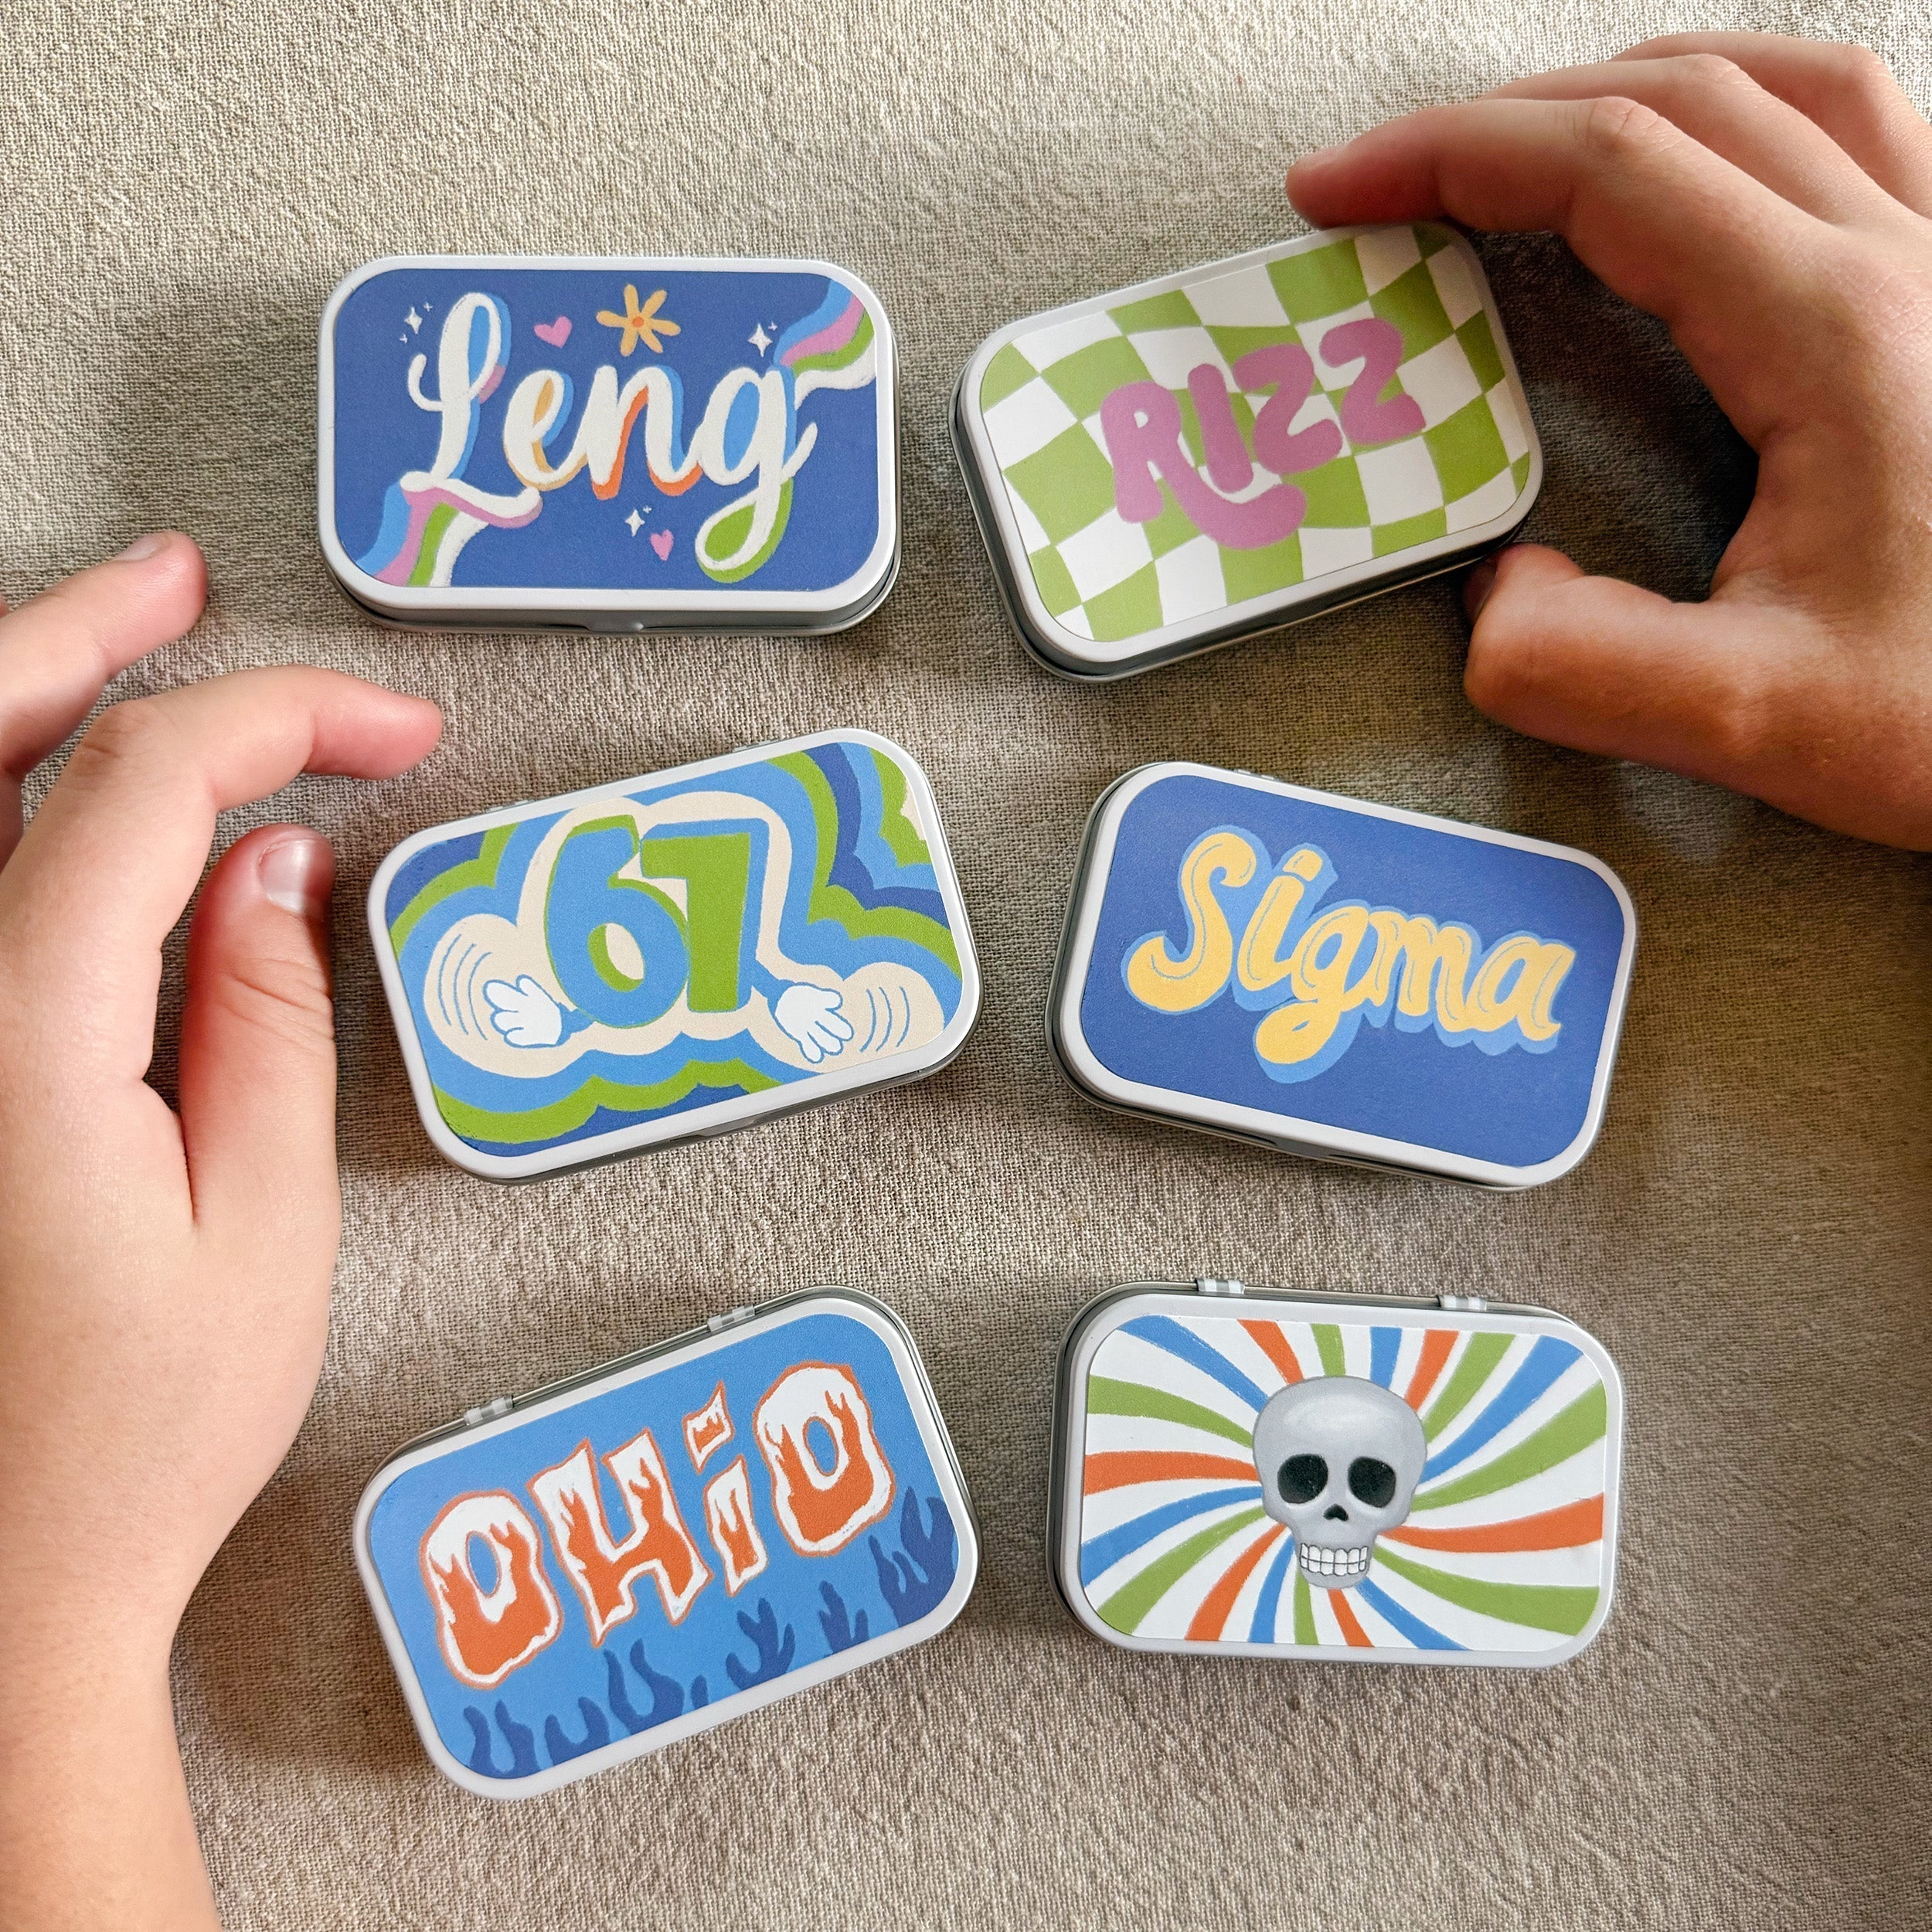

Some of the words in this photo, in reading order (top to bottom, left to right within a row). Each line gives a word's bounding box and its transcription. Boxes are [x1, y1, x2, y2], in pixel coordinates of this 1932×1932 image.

[406, 291, 818, 583] Leng
[1100, 317, 1427, 550] RIZZ
[543, 814, 771, 1029] 67
[1124, 829, 1577, 1070] Sigma
